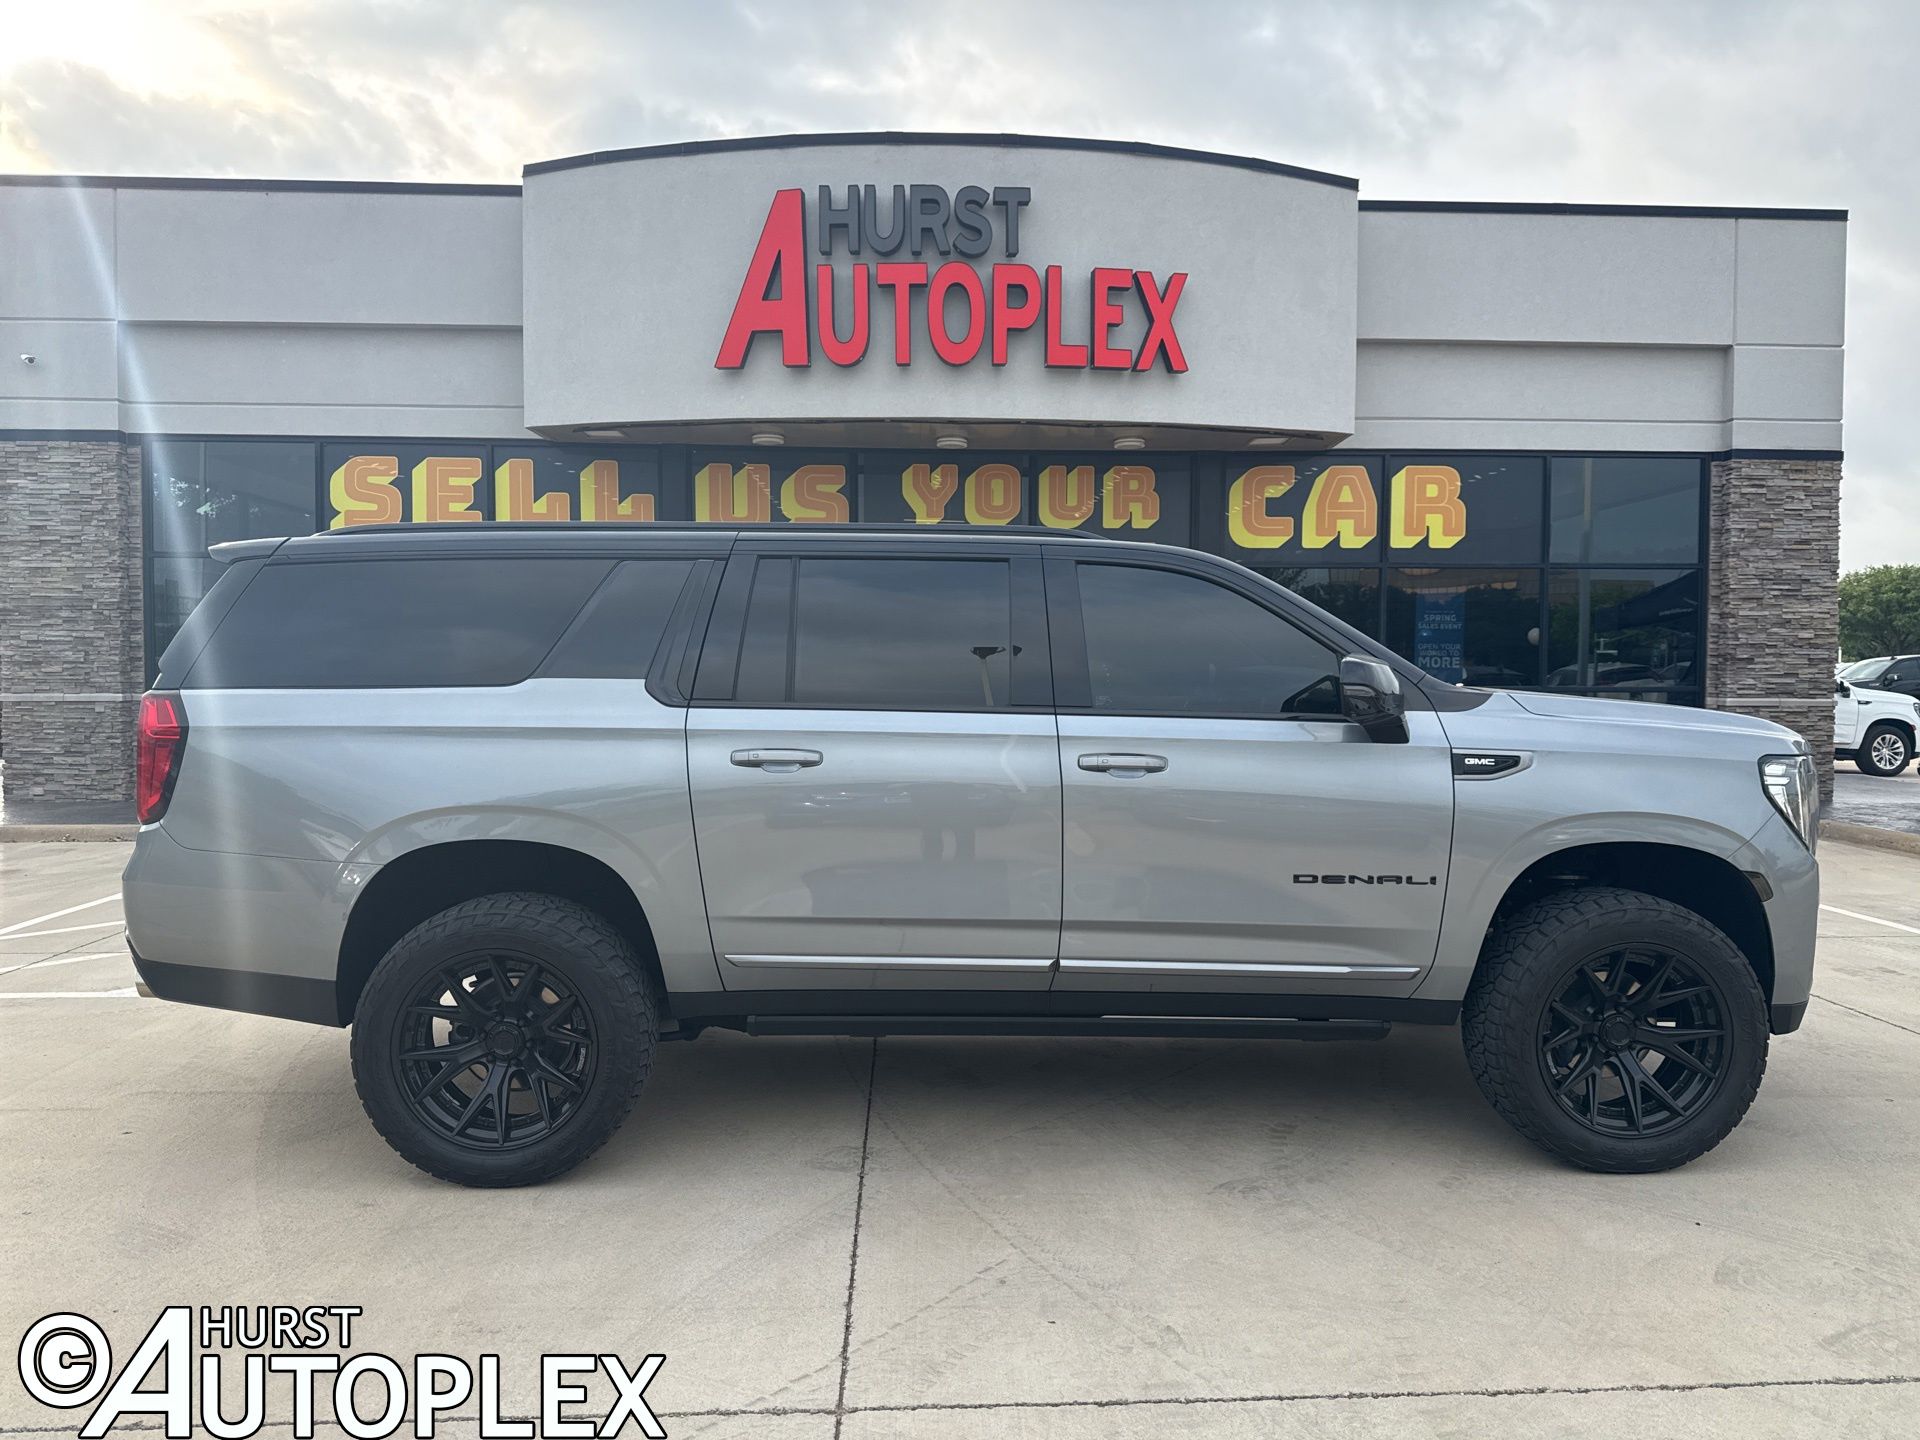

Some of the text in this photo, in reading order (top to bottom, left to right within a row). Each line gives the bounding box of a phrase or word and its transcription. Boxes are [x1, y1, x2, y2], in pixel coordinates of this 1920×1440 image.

[818, 184, 1031, 257] HURST
[714, 188, 1189, 374] AUTOPLEX
[329, 456, 1467, 549] SELL US YOUR CAR
[1423, 614, 1457, 622] SPRING
[1418, 657, 1461, 668] MORE
[1464, 757, 1496, 766] GMC
[1293, 873, 1437, 886] DENALI
